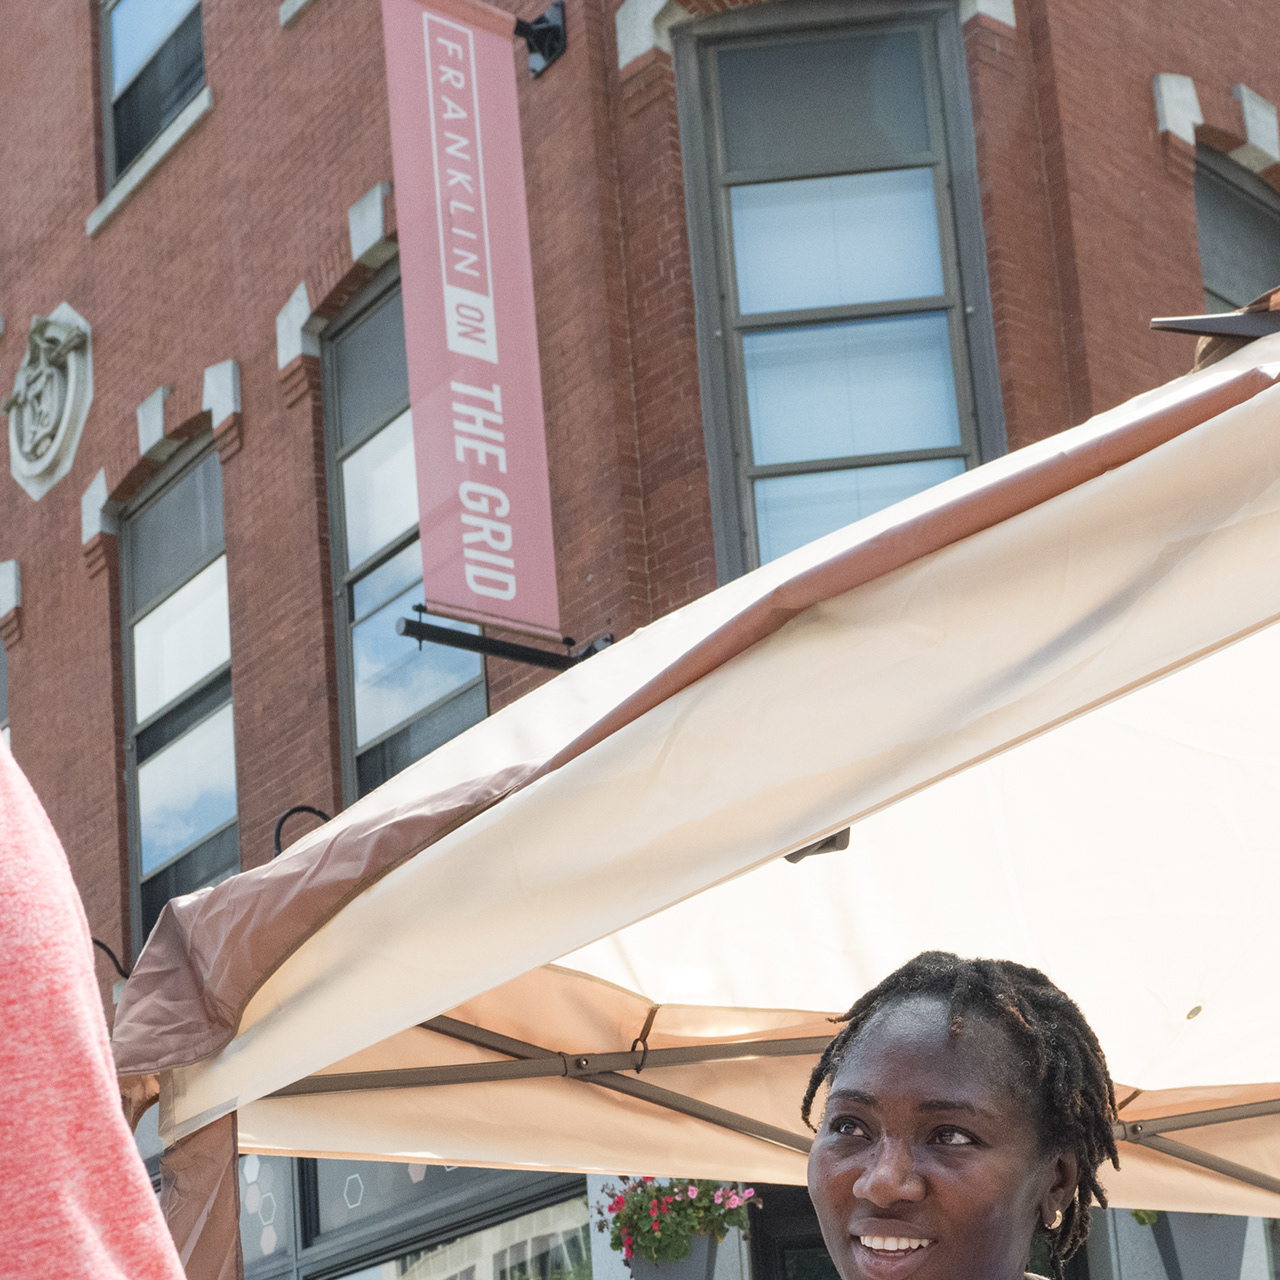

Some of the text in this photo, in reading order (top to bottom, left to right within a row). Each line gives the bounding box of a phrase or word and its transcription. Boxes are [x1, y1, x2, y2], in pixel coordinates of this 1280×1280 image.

[436, 36, 517, 602] FRANKLIN ON THE GRID
